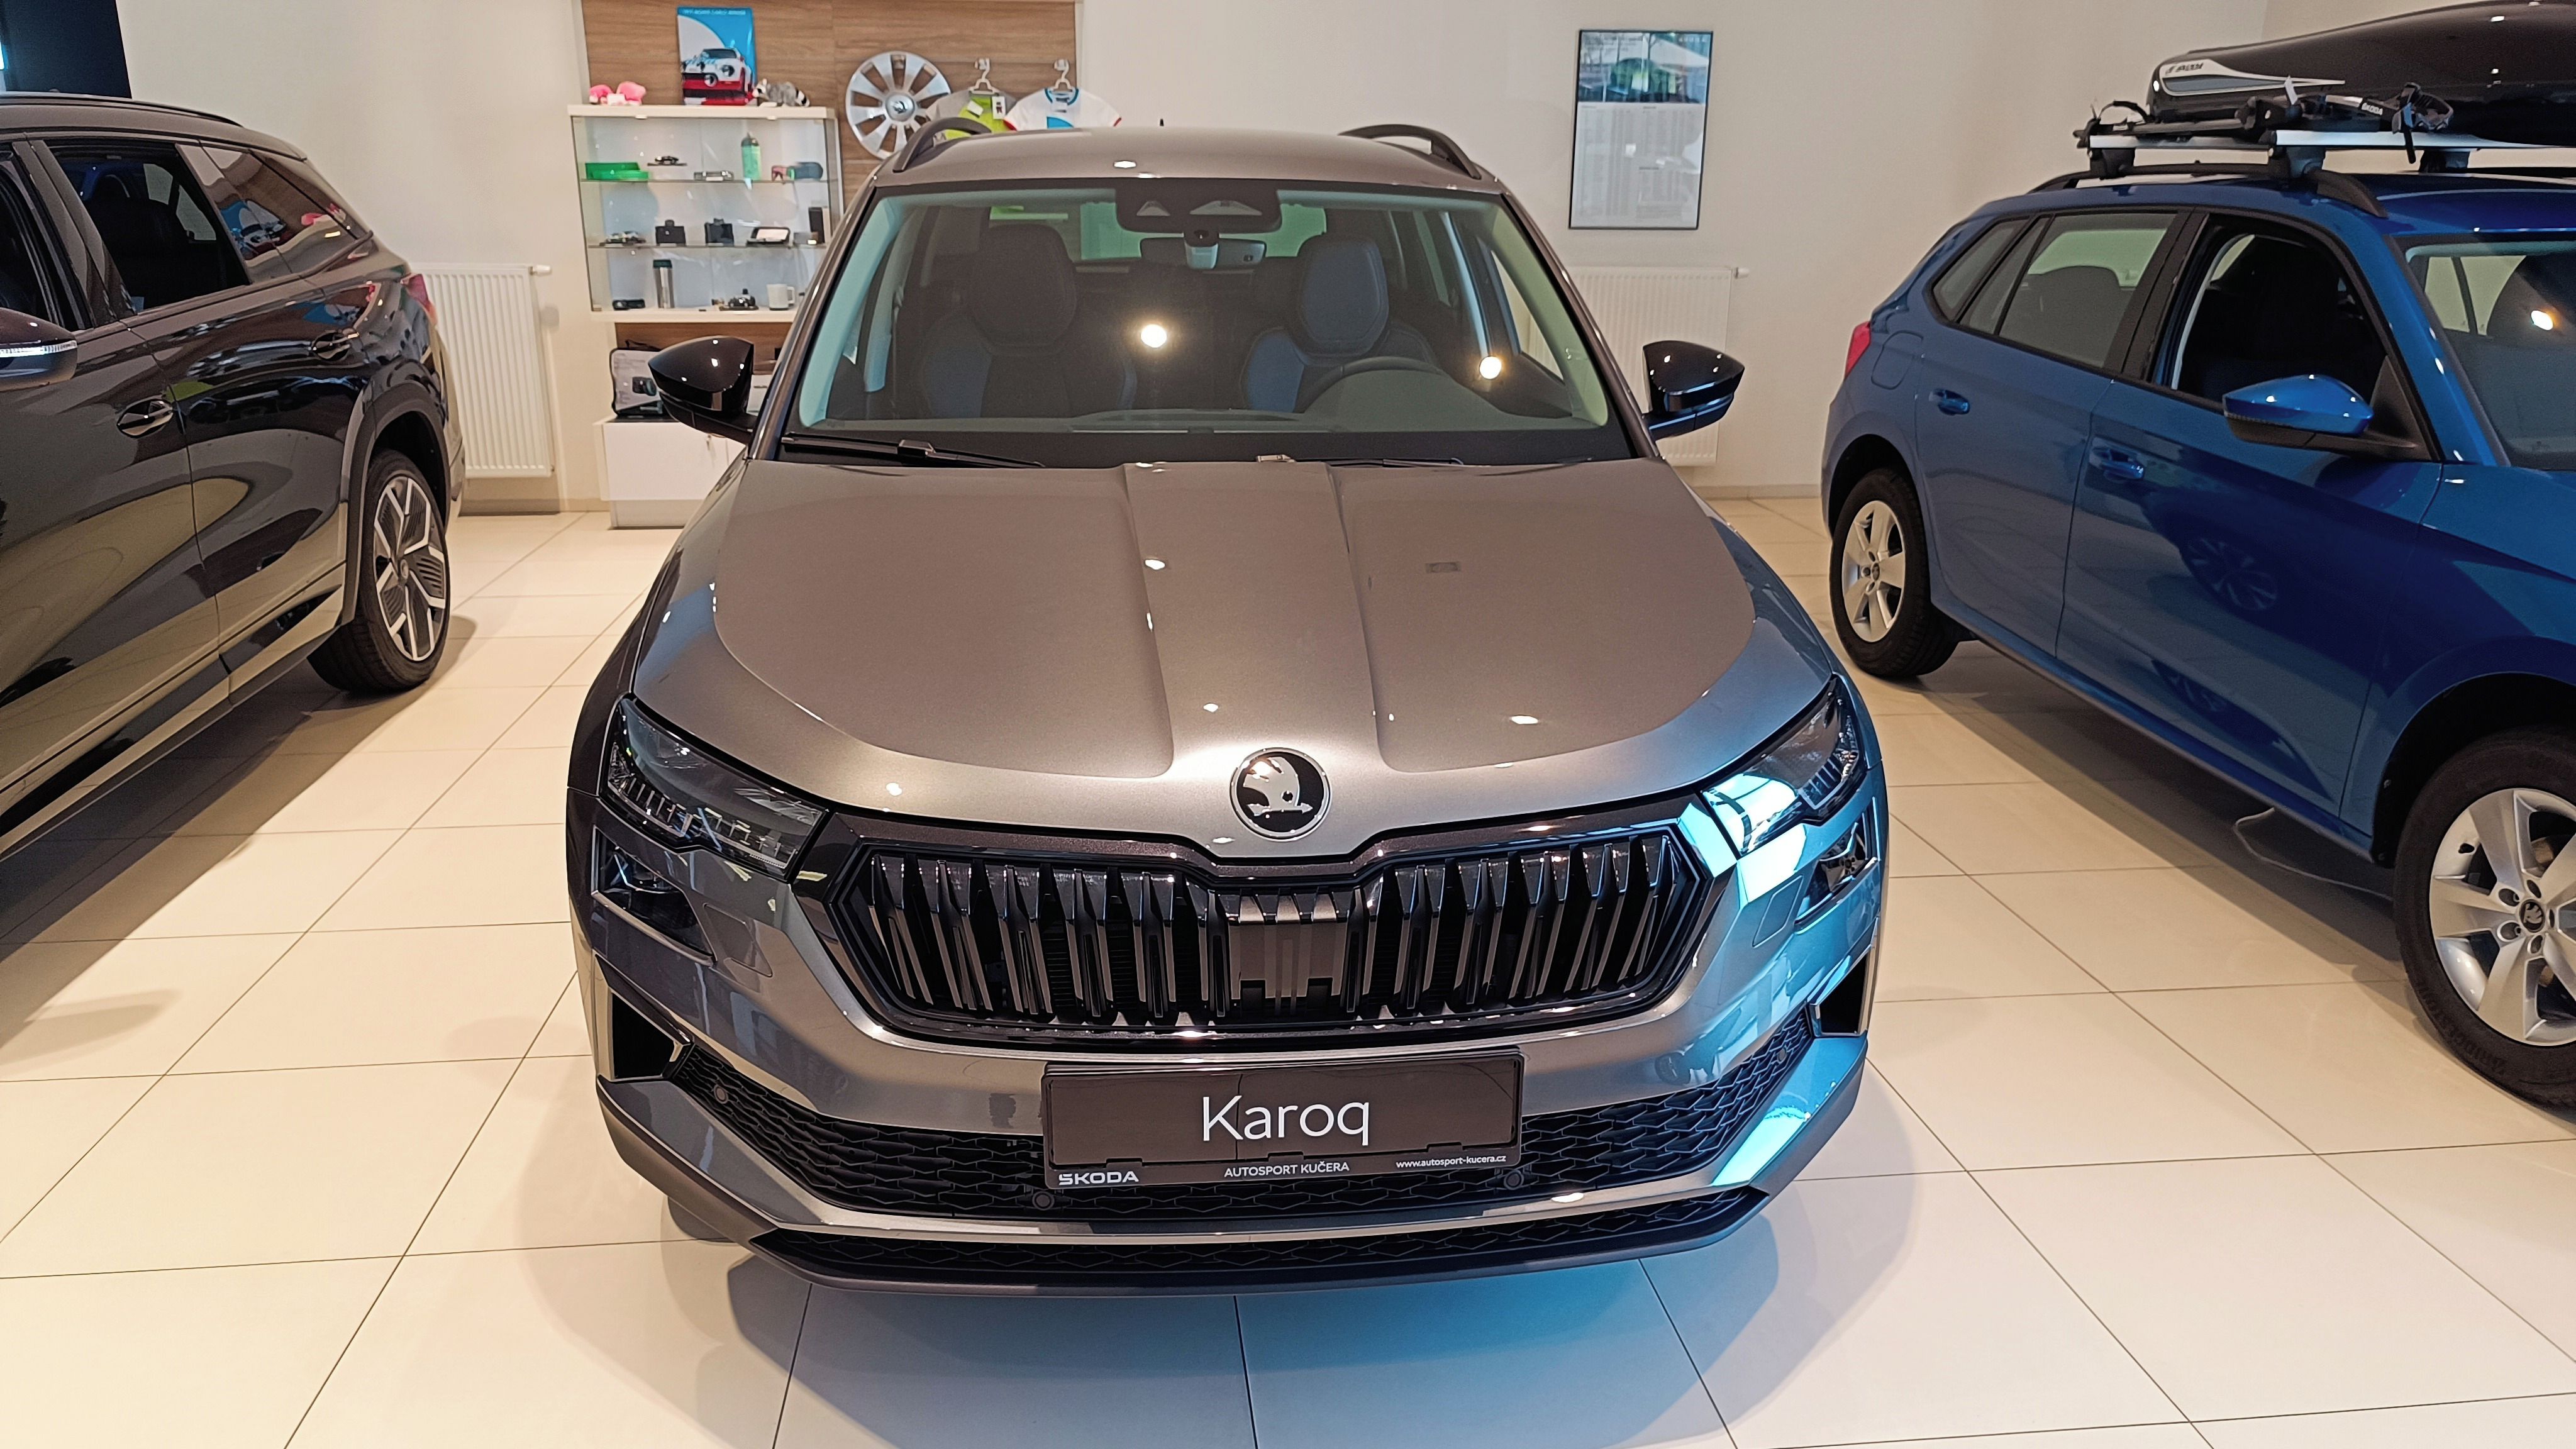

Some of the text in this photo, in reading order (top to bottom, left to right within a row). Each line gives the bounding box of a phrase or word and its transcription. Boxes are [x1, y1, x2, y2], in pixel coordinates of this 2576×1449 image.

[1202, 1095, 1369, 1146] Karoq
[1224, 1160, 1350, 1177] AUTOSPORT KUČERA
[1396, 1155, 1506, 1168] www.autosport-kucera.cz
